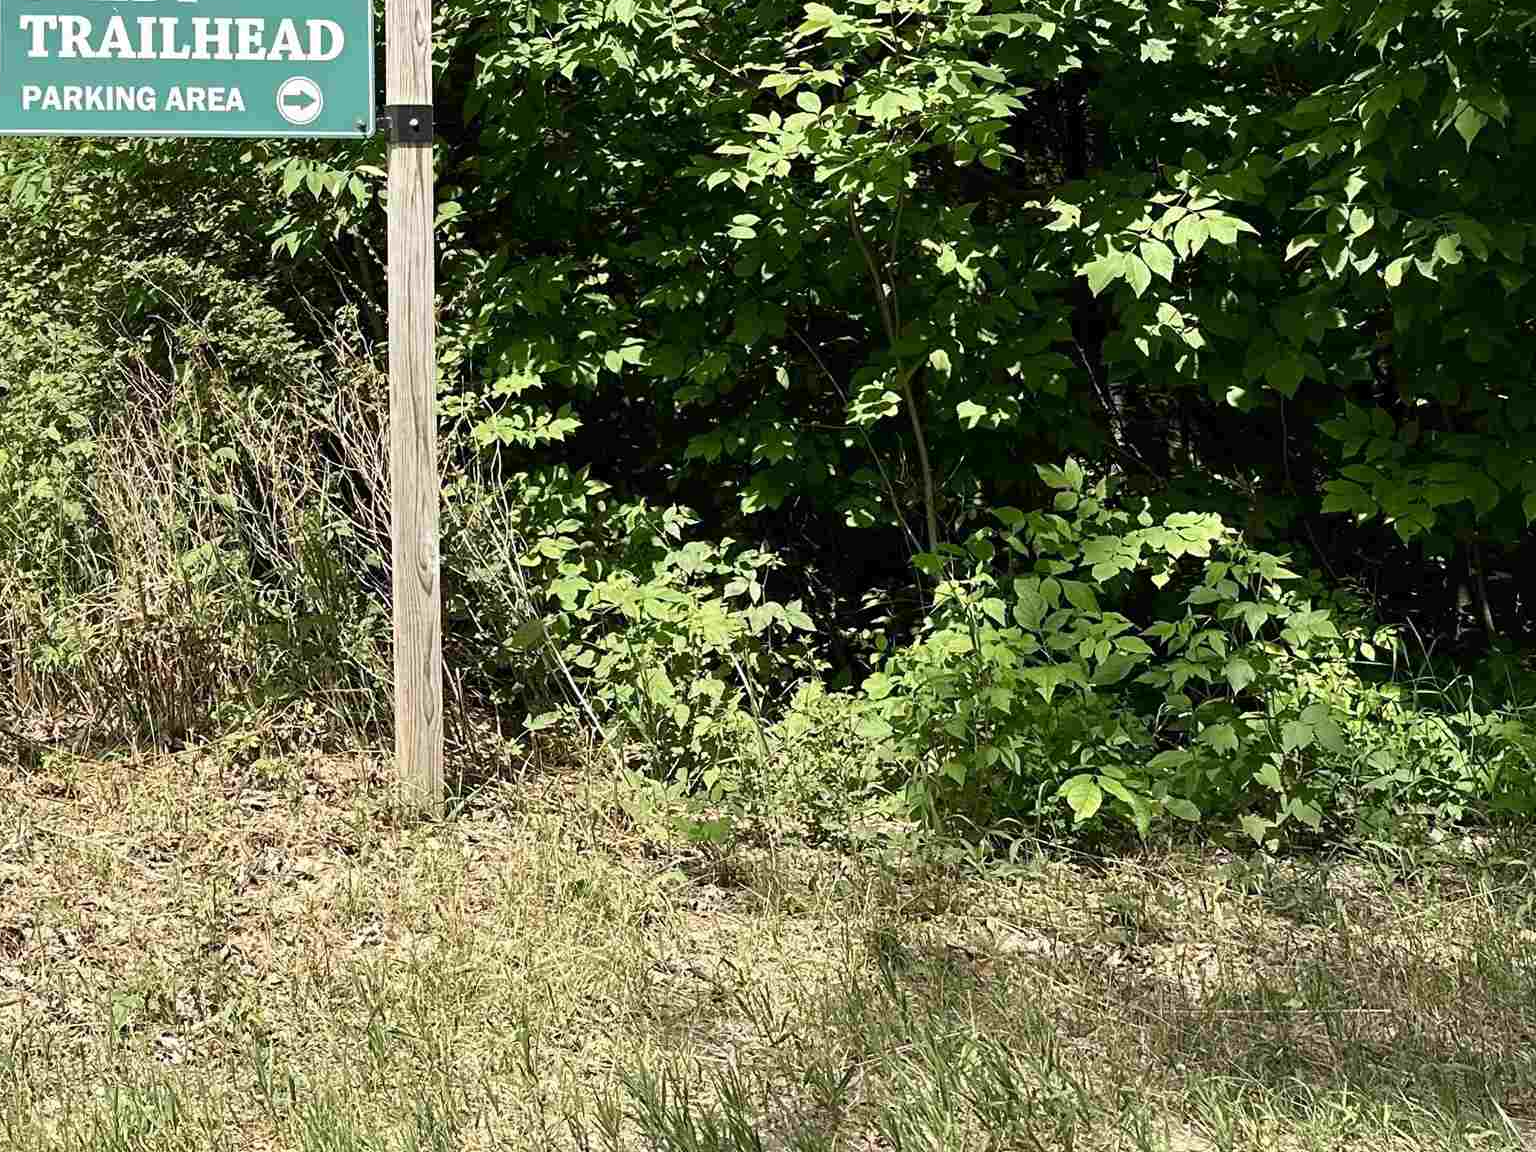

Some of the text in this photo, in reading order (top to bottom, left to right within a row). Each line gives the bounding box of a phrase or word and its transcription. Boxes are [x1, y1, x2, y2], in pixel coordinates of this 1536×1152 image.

[20, 14, 345, 61] TRAILHEAD
[22, 85, 246, 112] PARKING AREA
